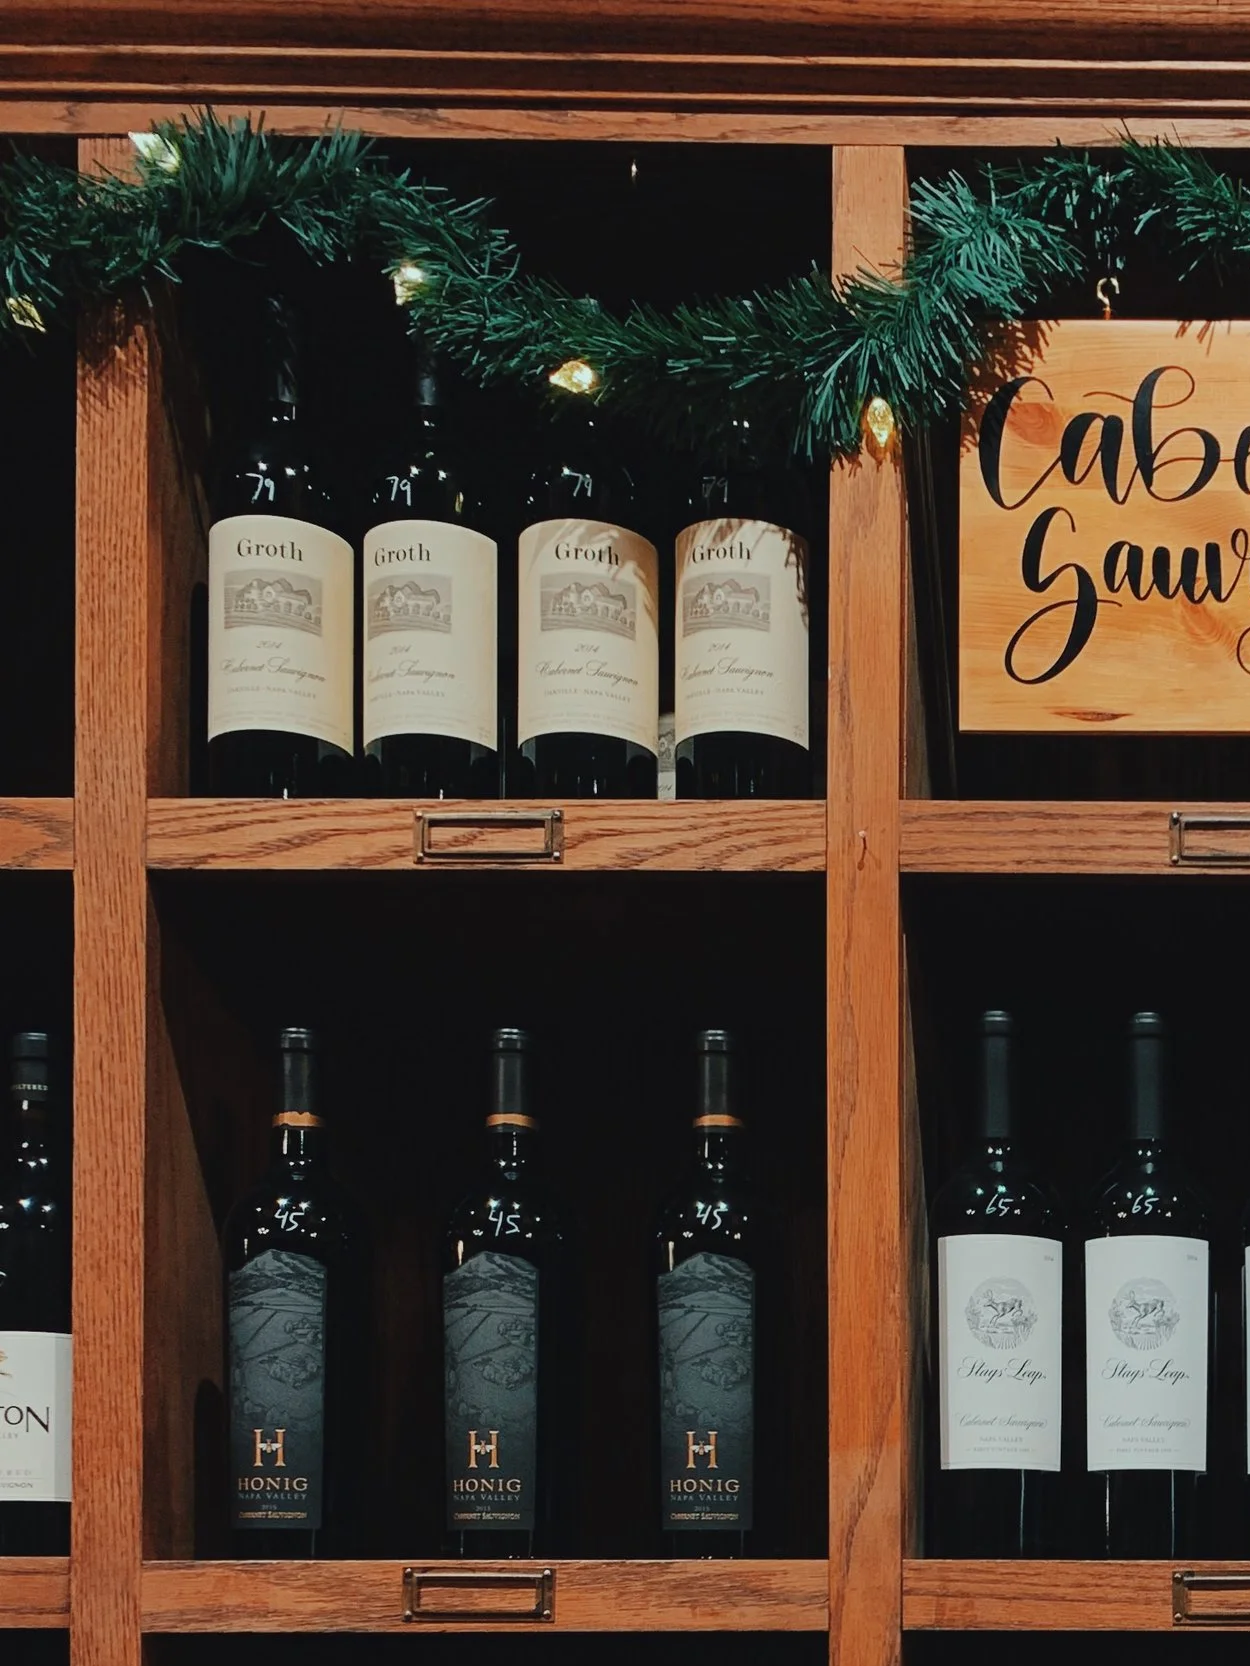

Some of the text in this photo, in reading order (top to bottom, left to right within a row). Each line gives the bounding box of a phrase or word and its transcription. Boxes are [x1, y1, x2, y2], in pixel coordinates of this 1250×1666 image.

[245, 473, 275, 501] 79
[385, 475, 412, 506] 79
[569, 471, 592, 497] 79
[237, 538, 303, 562] Groth
[374, 543, 431, 567] Groth
[555, 542, 619, 566] Groth
[692, 541, 752, 563] Groth
[696, 1204, 723, 1230] 45
[986, 1196, 1014, 1216] 65
[1131, 1196, 1157, 1215] 65
[274, 1206, 301, 1231] 45
[488, 1208, 520, 1236] 45
[252, 1428, 286, 1467] H
[467, 1429, 500, 1469] H
[685, 1430, 719, 1469] H
[237, 1477, 309, 1493] HONIG
[452, 1478, 522, 1494] HONIG
[669, 1478, 741, 1494] HONIG
